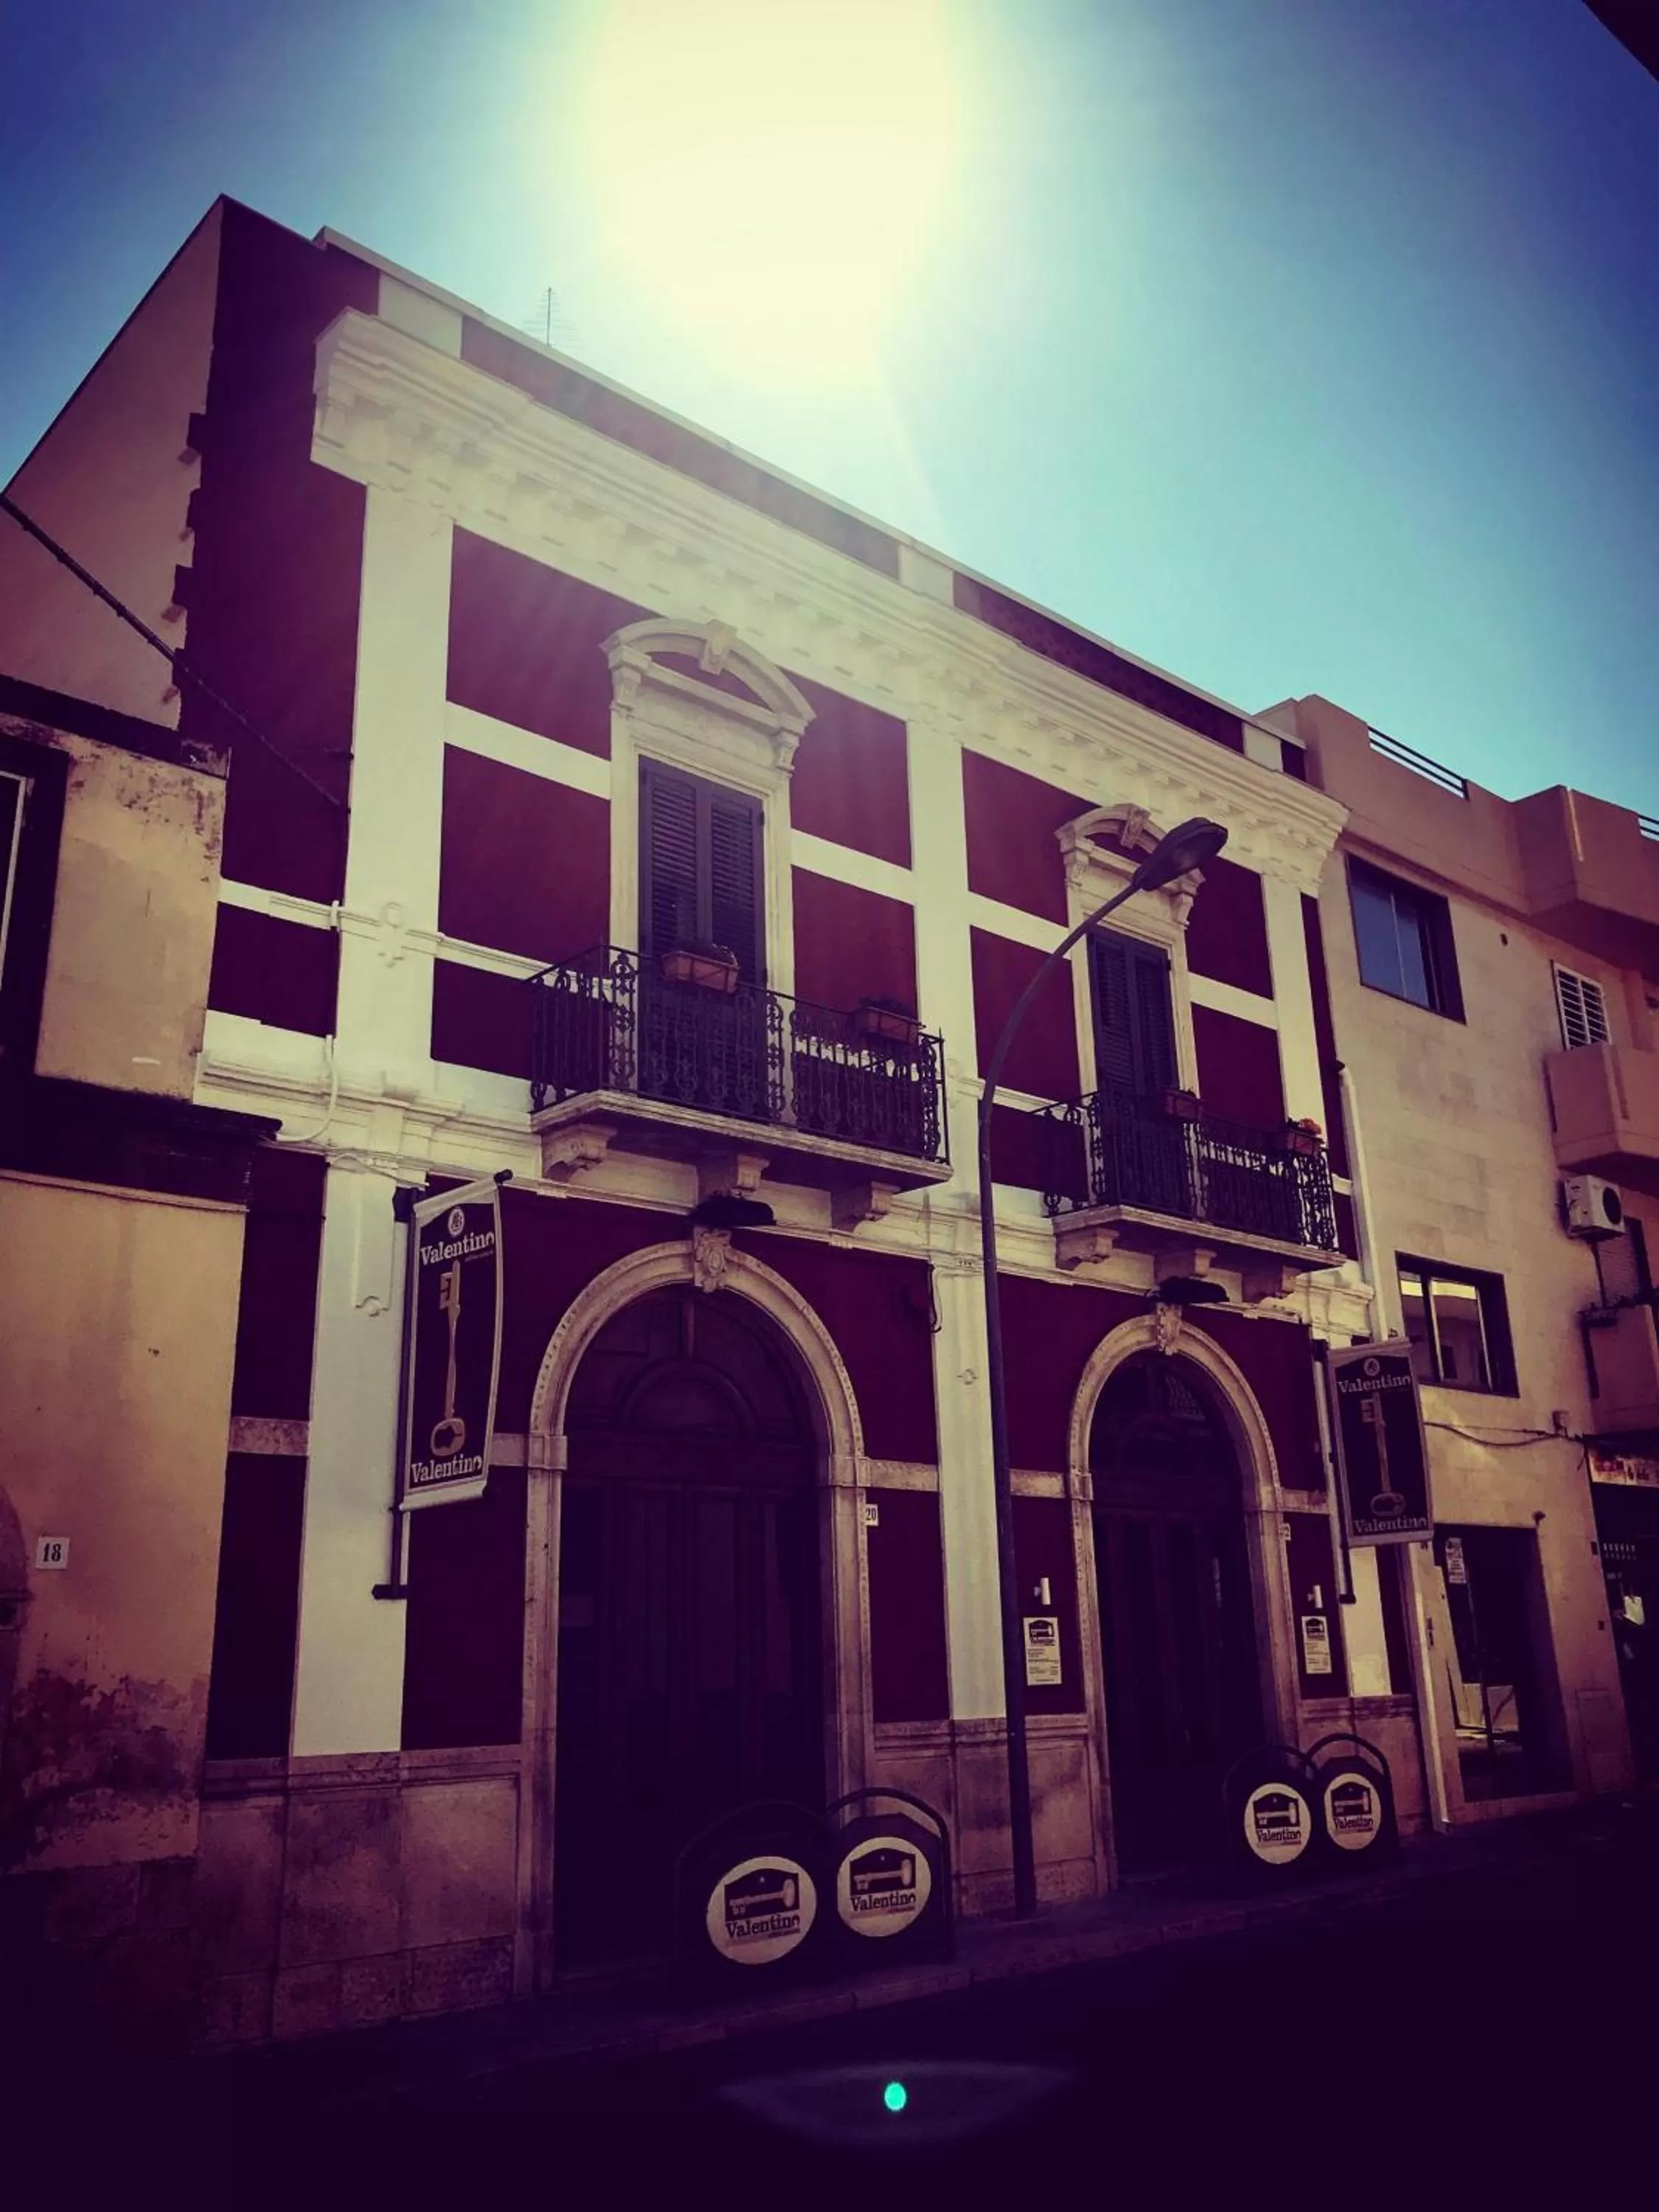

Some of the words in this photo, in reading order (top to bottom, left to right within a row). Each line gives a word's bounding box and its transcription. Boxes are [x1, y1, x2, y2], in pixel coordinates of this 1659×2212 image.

[420, 1231, 494, 1265] Valentino
[1338, 1373, 1411, 1393] Valentino
[411, 1453, 483, 1483] Valentino
[866, 1508, 877, 1520] 20
[1354, 1516, 1427, 1533] Valentino
[44, 1543, 61, 1562] 18
[1333, 1817, 1374, 1829] Valentino
[1256, 1828, 1301, 1843] Valentino
[850, 1891, 916, 1911] Valentino
[726, 1913, 800, 1938] Valentino
